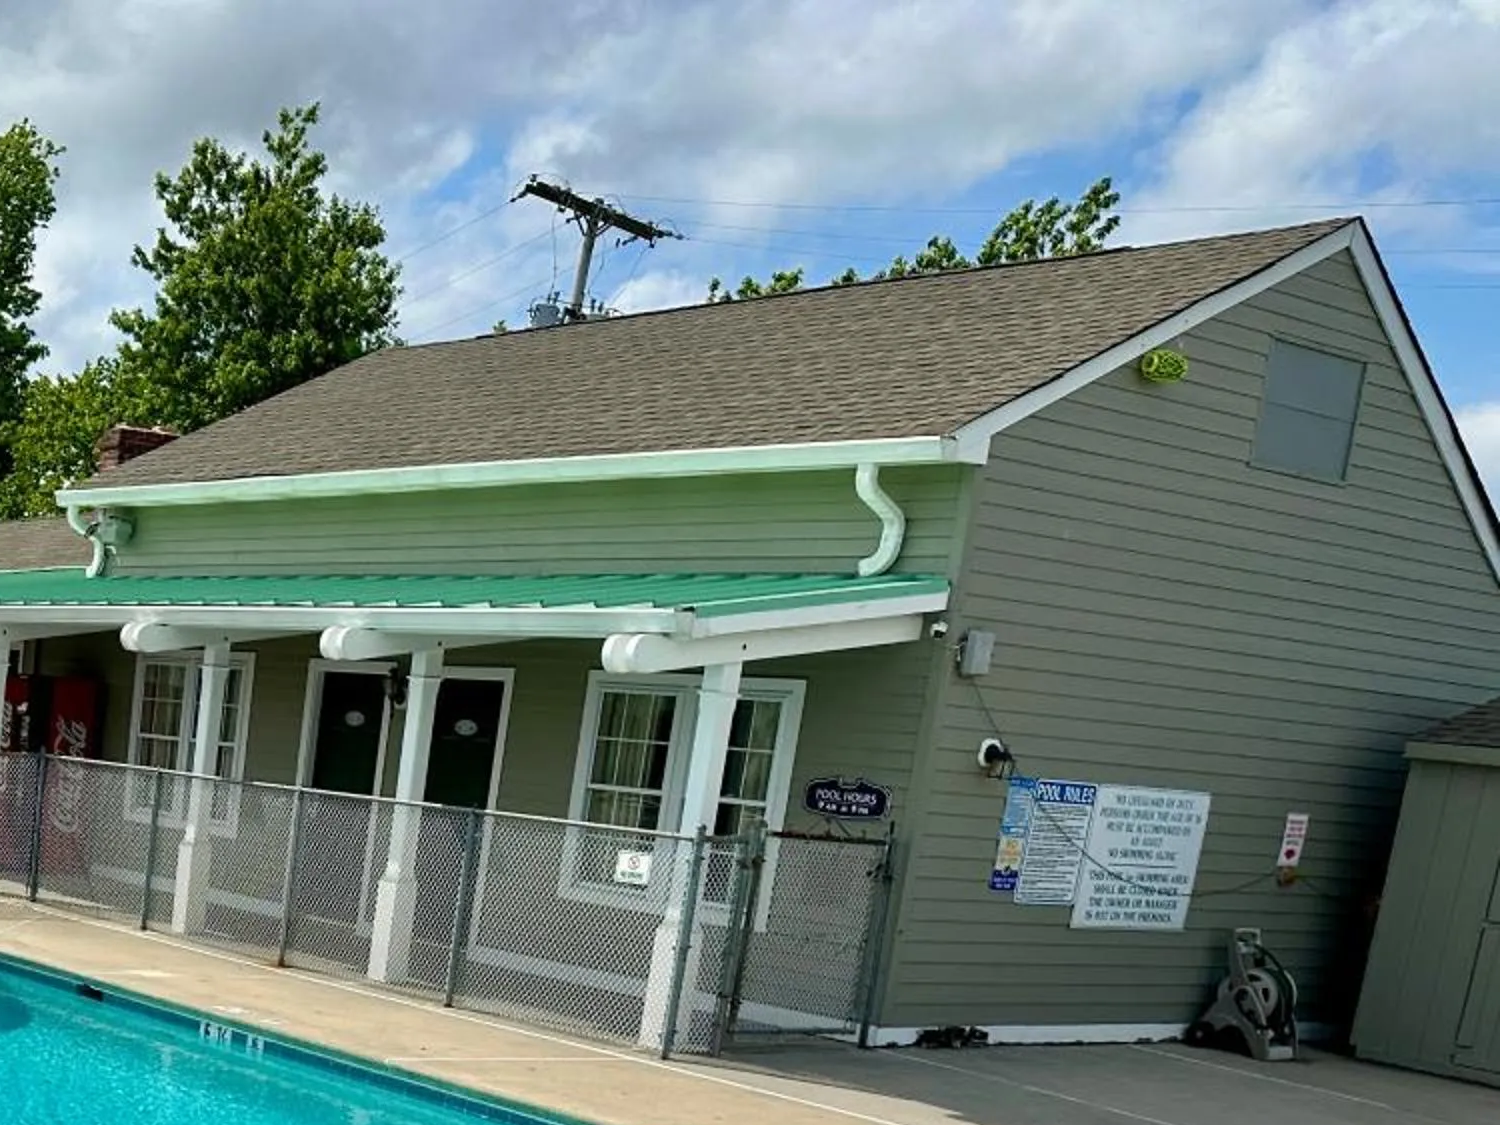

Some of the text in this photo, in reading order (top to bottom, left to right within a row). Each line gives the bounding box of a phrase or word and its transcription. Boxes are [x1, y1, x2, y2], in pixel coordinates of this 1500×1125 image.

[815, 788, 877, 805] POOL HOURS
[1038, 783, 1061, 800] POOL
[1063, 786, 1094, 802] RULES
